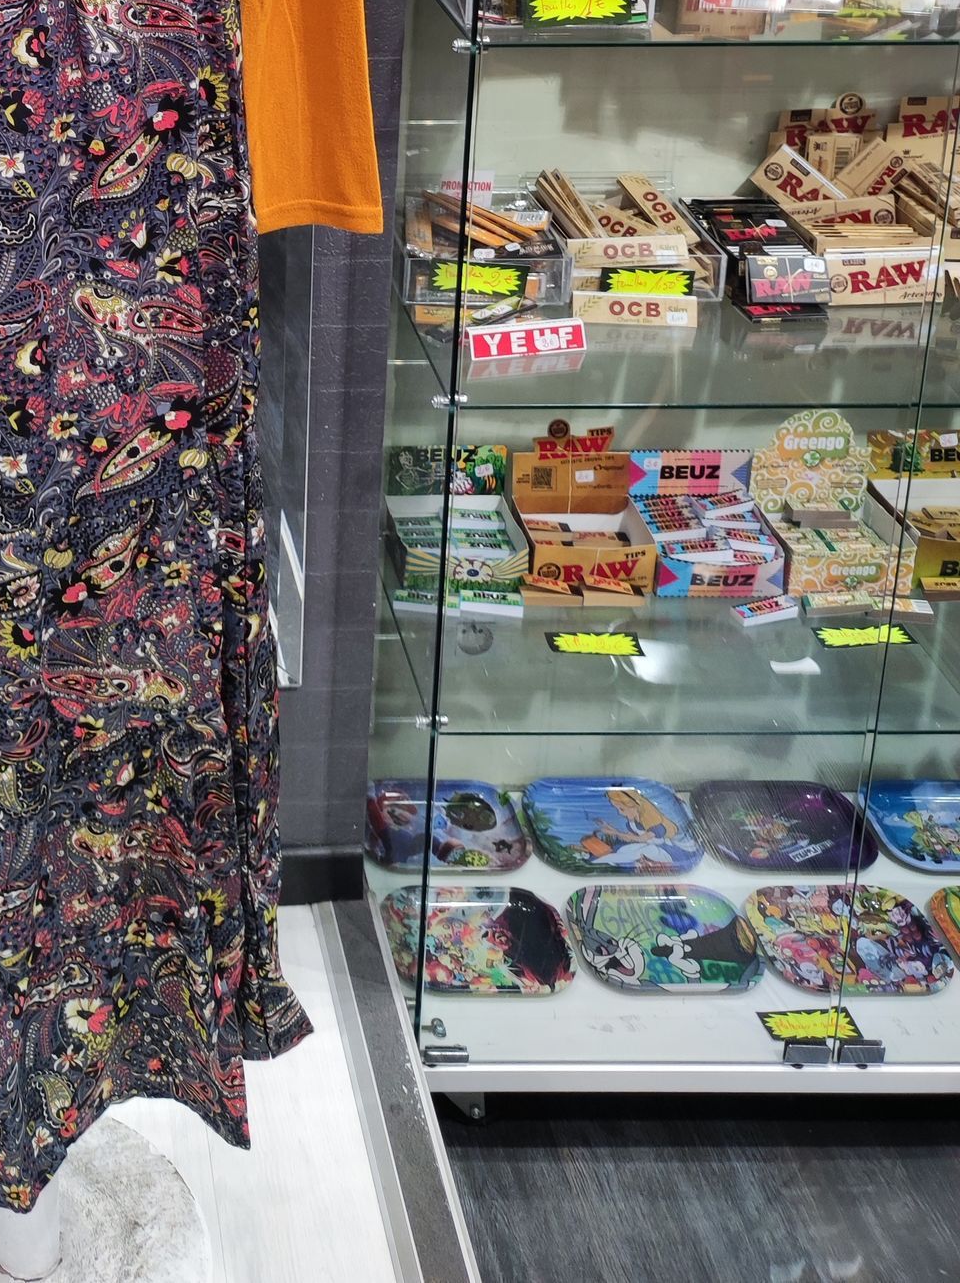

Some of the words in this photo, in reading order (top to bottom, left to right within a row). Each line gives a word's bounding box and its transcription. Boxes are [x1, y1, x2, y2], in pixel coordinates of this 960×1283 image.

[643, 192, 676, 224] OCB
[598, 215, 638, 237] OCB
[603, 243, 654, 259] OCB
[848, 259, 926, 294] RAW
[753, 273, 814, 298] RAW
[609, 300, 661, 318] OCB
[588, 427, 613, 438] TIPS
[537, 436, 609, 460] RAW
[783, 435, 846, 451] Greengo
[659, 465, 721, 480] BEUZ
[624, 550, 646, 559] TIPS
[562, 559, 640, 583] RAW
[830, 563, 877, 577] Greengo
[690, 573, 756, 587] BEUZ
[748, 599, 782, 613] BEUZ
